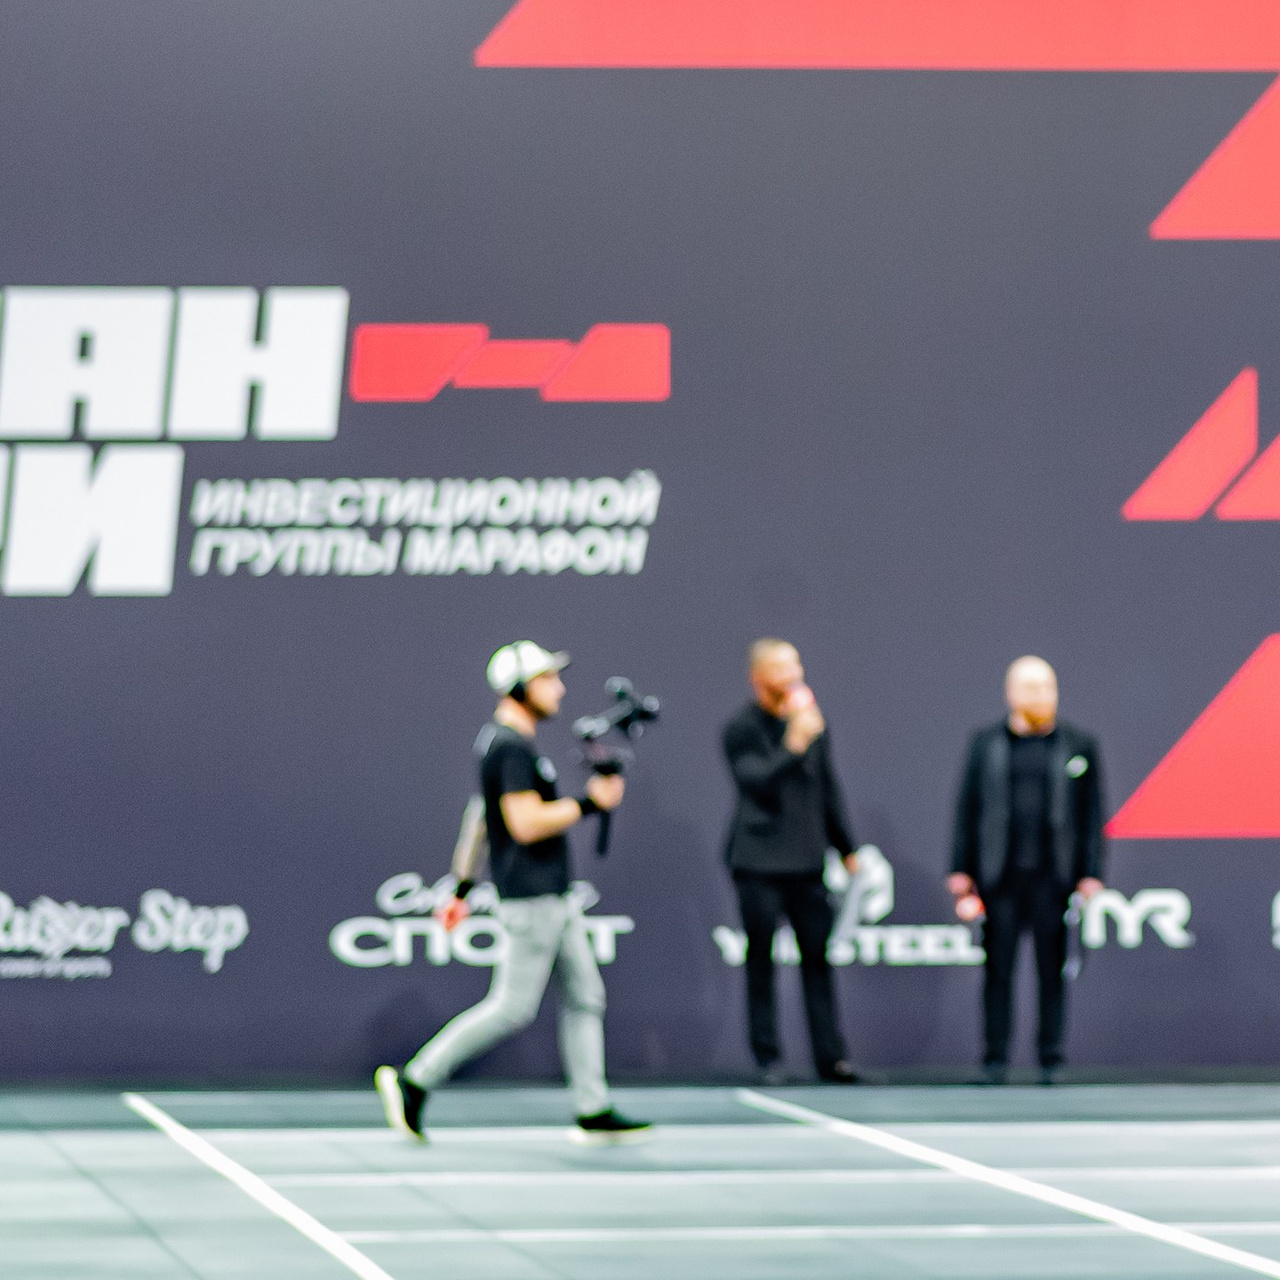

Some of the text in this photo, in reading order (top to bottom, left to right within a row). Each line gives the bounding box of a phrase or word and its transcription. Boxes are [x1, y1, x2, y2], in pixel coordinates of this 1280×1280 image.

[191, 470, 662, 526] ИНВЕСТИЦИОННОЙ
[191, 528, 649, 576] ГРУППЫ МАРАФОН
[328, 916, 636, 968] СПОТ
